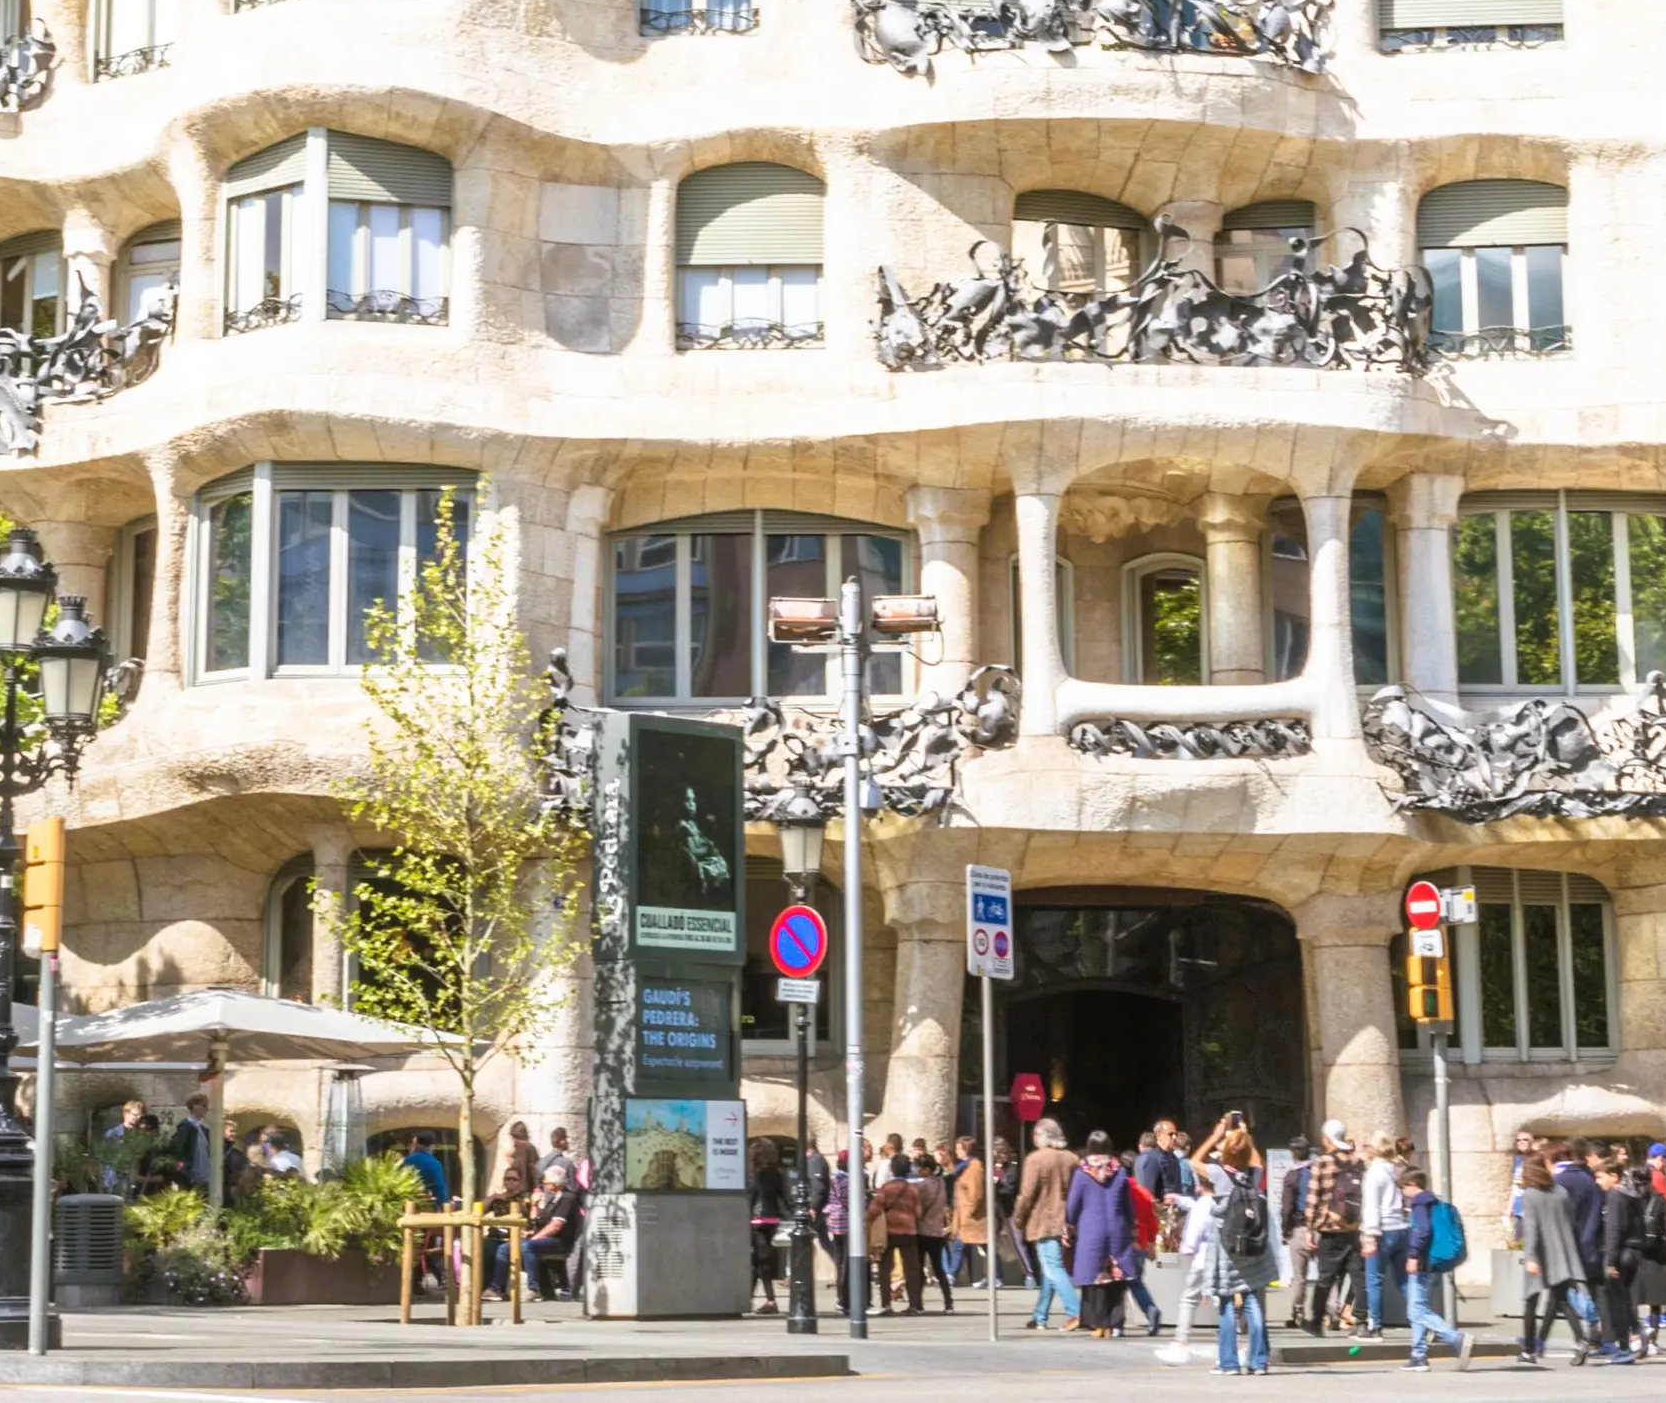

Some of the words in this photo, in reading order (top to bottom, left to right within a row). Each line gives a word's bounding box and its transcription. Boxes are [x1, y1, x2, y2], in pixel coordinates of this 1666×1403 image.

[687, 916, 732, 933] ESSENCIAL
[642, 1009, 700, 1027] PEDRERA:
[642, 1030, 665, 1046] THE
[668, 1031, 716, 1049] ORIGINS
